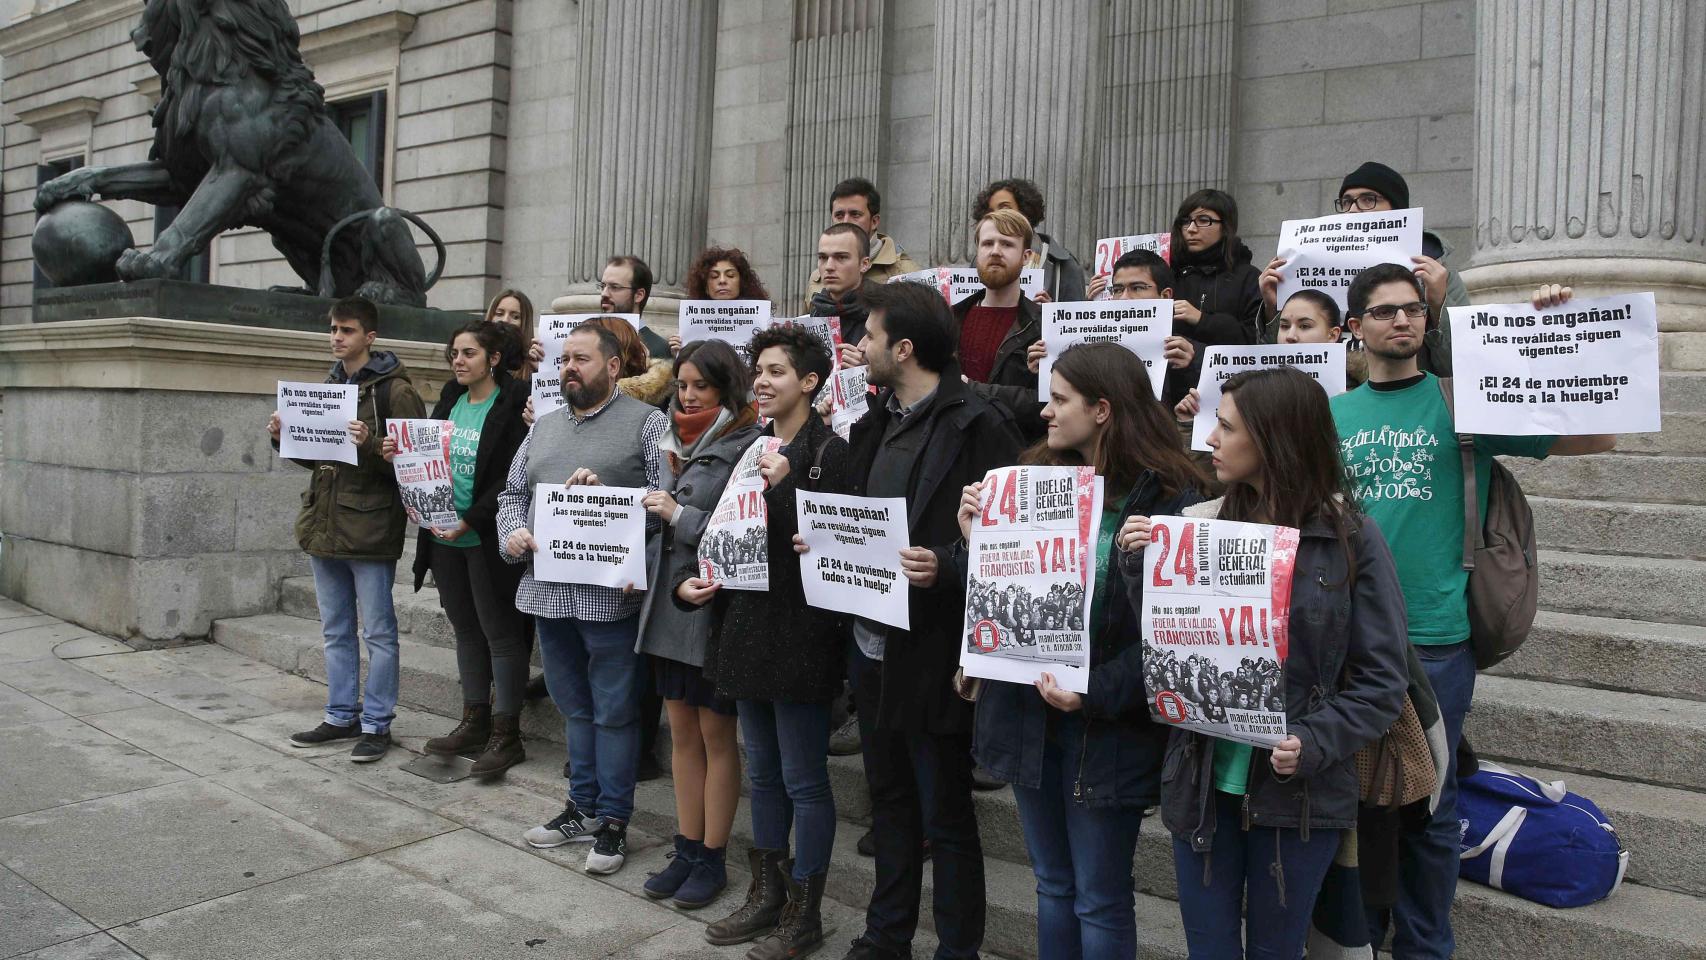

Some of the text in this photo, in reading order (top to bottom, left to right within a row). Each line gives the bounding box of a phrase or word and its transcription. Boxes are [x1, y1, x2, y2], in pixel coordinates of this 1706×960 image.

[1295, 216, 1408, 236] ¡No nos engañan!
[1300, 237, 1320, 246] ¡Las
[1367, 234, 1399, 244] siguen
[1326, 244, 1369, 253] vigentes!
[1098, 240, 1120, 276] 24
[950, 274, 965, 285] ¡No
[1296, 268, 1310, 278] ¡El
[1312, 268, 1326, 276] 24
[1328, 267, 1342, 276] de
[1302, 278, 1328, 287] todos
[1340, 278, 1350, 286] la
[686, 306, 698, 316] ¡No
[718, 306, 759, 316] engañan!
[1053, 307, 1157, 323] ¡No nos engañan!
[1470, 304, 1631, 329] ¡No nos engañan!
[549, 320, 564, 330] ¡No
[1060, 324, 1148, 335] ¡Las reválidas siguen
[1084, 334, 1122, 342] vigentes!
[1482, 330, 1621, 345] ¡Las reválidas siguen
[1519, 344, 1579, 358] vigentes!
[1209, 351, 1328, 368] ¡No nos engañan!
[535, 379, 546, 390] ¡No
[1480, 374, 1628, 390] ¡El 24 de noviembre
[281, 387, 292, 398] ¡No
[309, 390, 346, 400] engañan!
[1486, 388, 1619, 404] todos a la huelga!
[322, 436, 345, 445] huelga!
[389, 421, 412, 454] 24
[1338, 430, 1386, 452] SCUELA
[424, 460, 446, 480] YA!
[1369, 459, 1424, 474] TOD@S
[1018, 468, 1029, 510] noviembre
[1036, 477, 1073, 495] HUELGA
[1374, 484, 1432, 501] TOD@S
[548, 491, 634, 507] ¡No nos engañan!
[737, 491, 762, 520] YA!
[982, 470, 1018, 526] 24
[1036, 493, 1074, 509] GENERAL
[553, 507, 568, 516] ¡Las
[604, 511, 628, 520] siguen
[803, 500, 890, 521] ¡No nos engañan!
[1037, 507, 1074, 521] estudiantil
[811, 520, 826, 530] ¡Las
[861, 526, 886, 538] siguen
[549, 540, 629, 554] ¡El 24 de noviembre
[834, 533, 866, 546] vigentes!
[1219, 538, 1266, 555] HUELGA
[554, 551, 576, 560] todos
[586, 552, 594, 561] la
[597, 553, 624, 565] huelga!
[1036, 537, 1075, 574] YA!
[1151, 522, 1197, 587] 24
[1196, 523, 1210, 586] de noviembre
[817, 557, 896, 580] ¡El 24 de noviembre
[980, 562, 1035, 578] FRANQUISTAS
[1219, 555, 1266, 571] GENERAL
[822, 571, 892, 594] todos a la huelga!
[1220, 572, 1265, 585] estudiantil
[1175, 605, 1200, 616] engañan!
[1219, 606, 1269, 647] YA!
[1038, 632, 1081, 643] manifestación
[1154, 630, 1220, 646] FRANQUISTAS
[1230, 713, 1282, 724] manifestación
